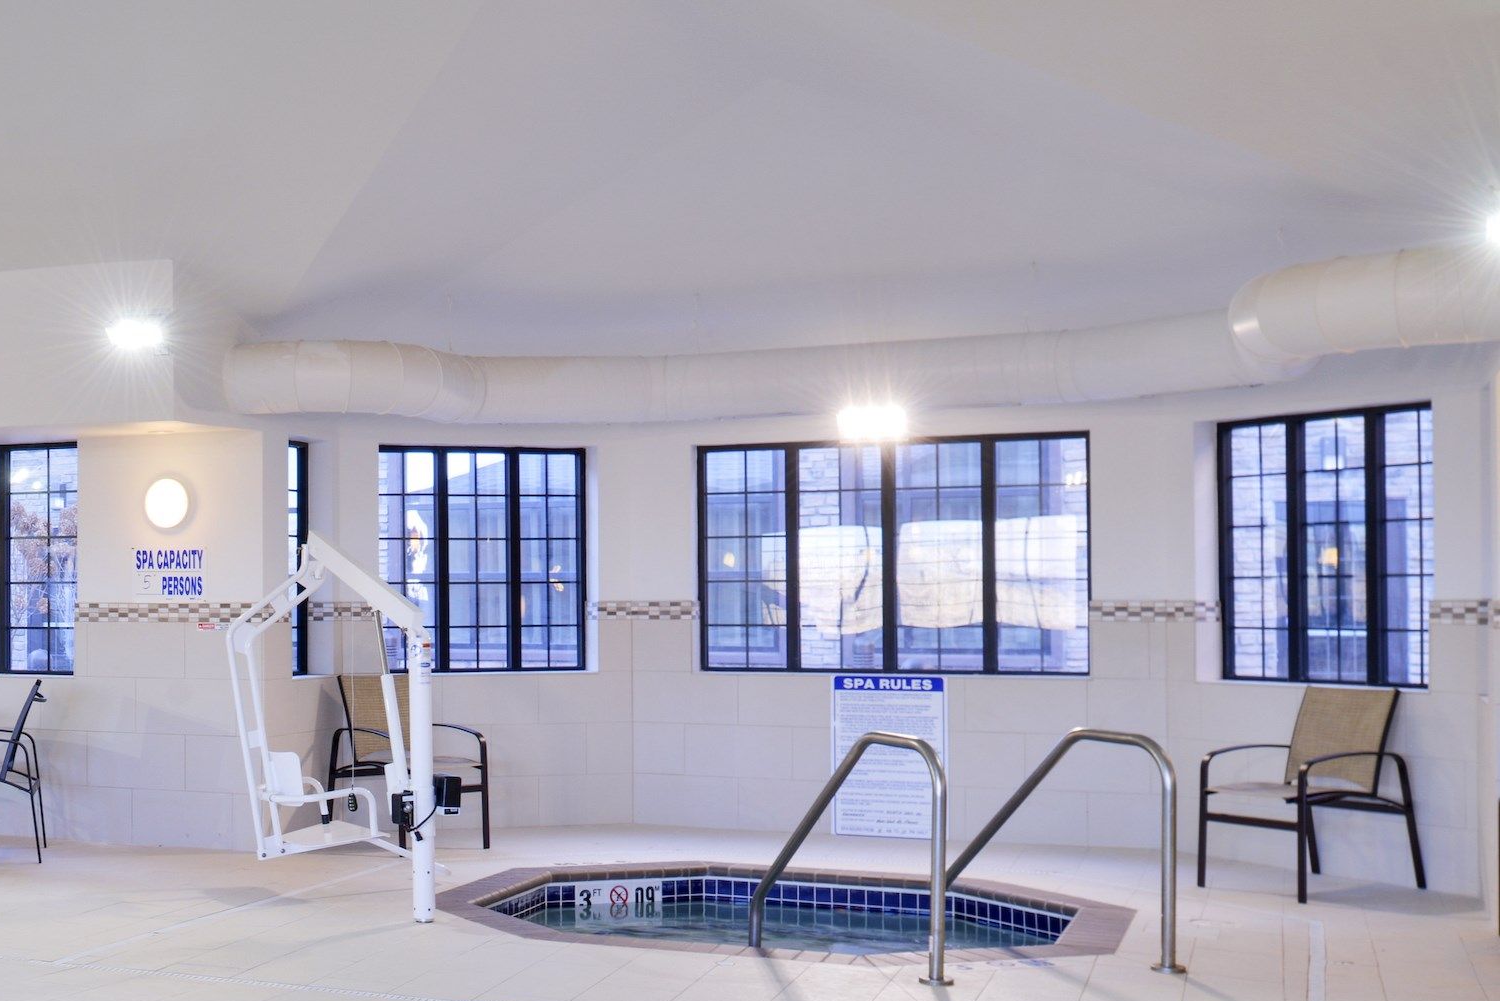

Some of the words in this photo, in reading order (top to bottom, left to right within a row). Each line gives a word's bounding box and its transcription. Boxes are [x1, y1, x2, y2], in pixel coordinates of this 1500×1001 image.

[136, 549, 154, 569] SPA
[156, 549, 203, 569] CAPACITY
[162, 576, 203, 596] PERSONS
[843, 677, 875, 690] SPA
[879, 678, 933, 691] RULES
[579, 889, 592, 906] 3
[592, 888, 602, 896] FT
